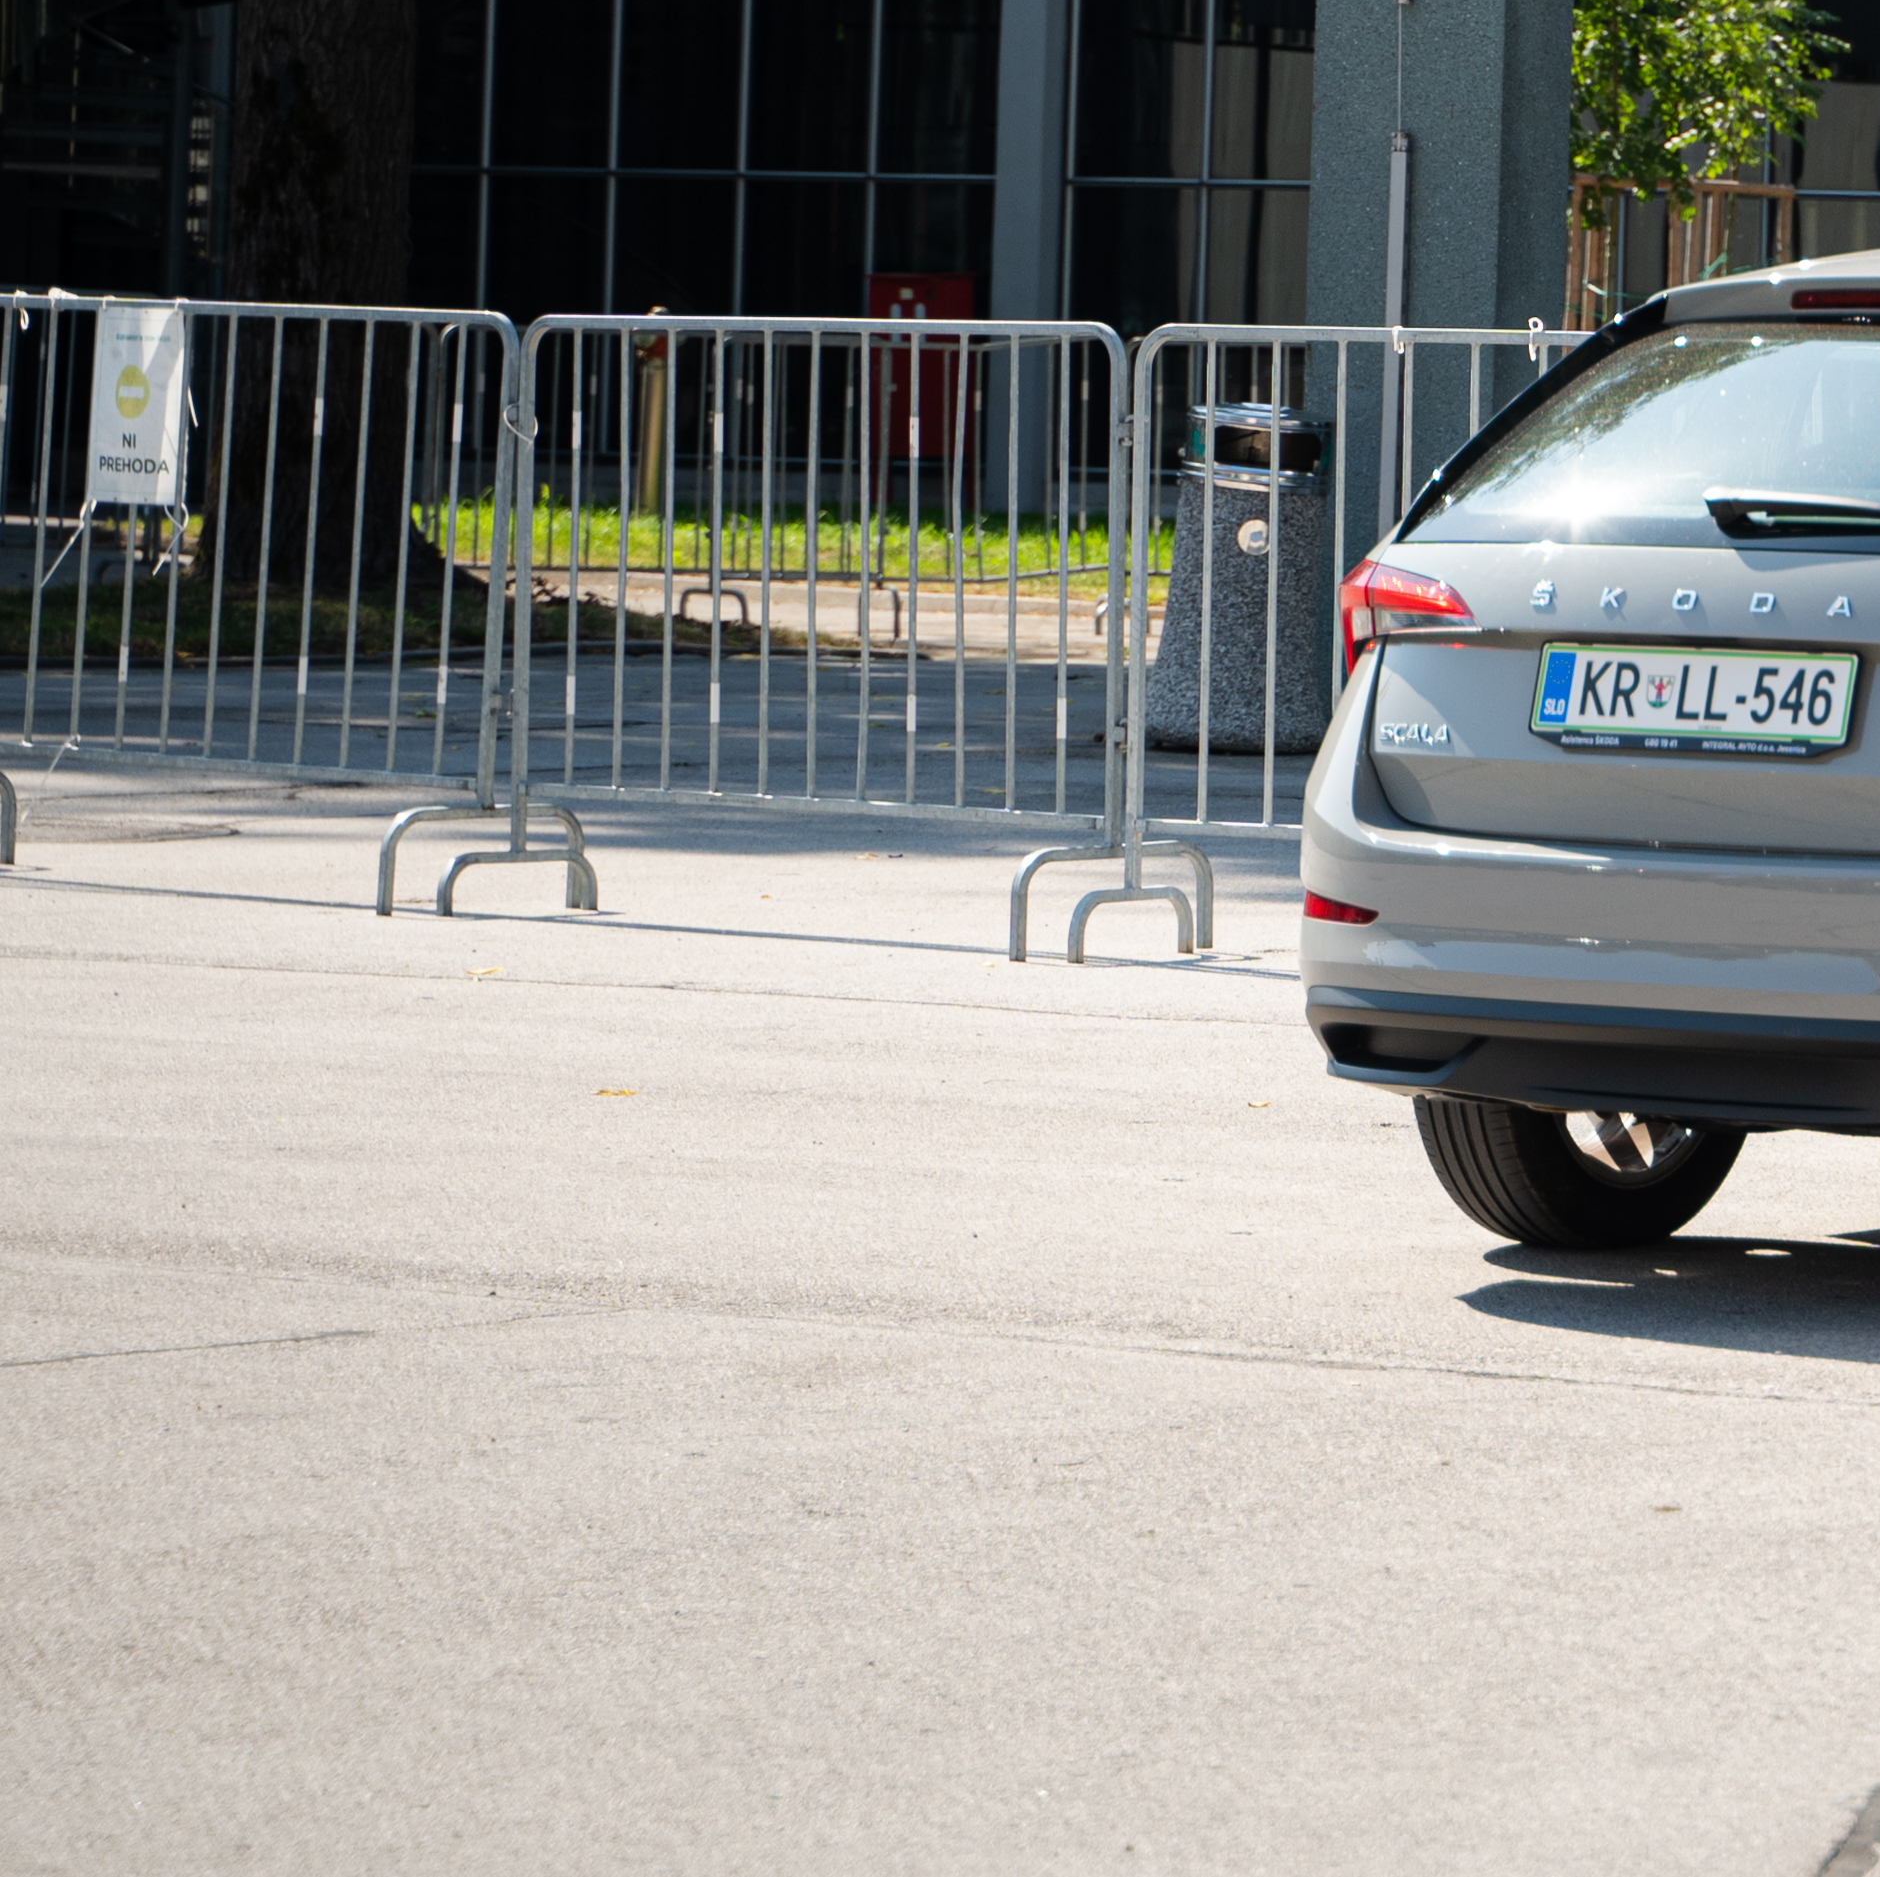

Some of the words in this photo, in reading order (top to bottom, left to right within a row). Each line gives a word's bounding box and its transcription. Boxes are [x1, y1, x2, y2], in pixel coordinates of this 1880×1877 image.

[122, 432, 137, 449] NI
[99, 455, 170, 475] PREHODA
[1530, 579, 1851, 617] ŠKODA
[1578, 660, 1641, 717] KR
[1675, 664, 1836, 726] LL-546
[1543, 698, 1565, 716] SLO
[1380, 722, 1450, 745] SCALA
